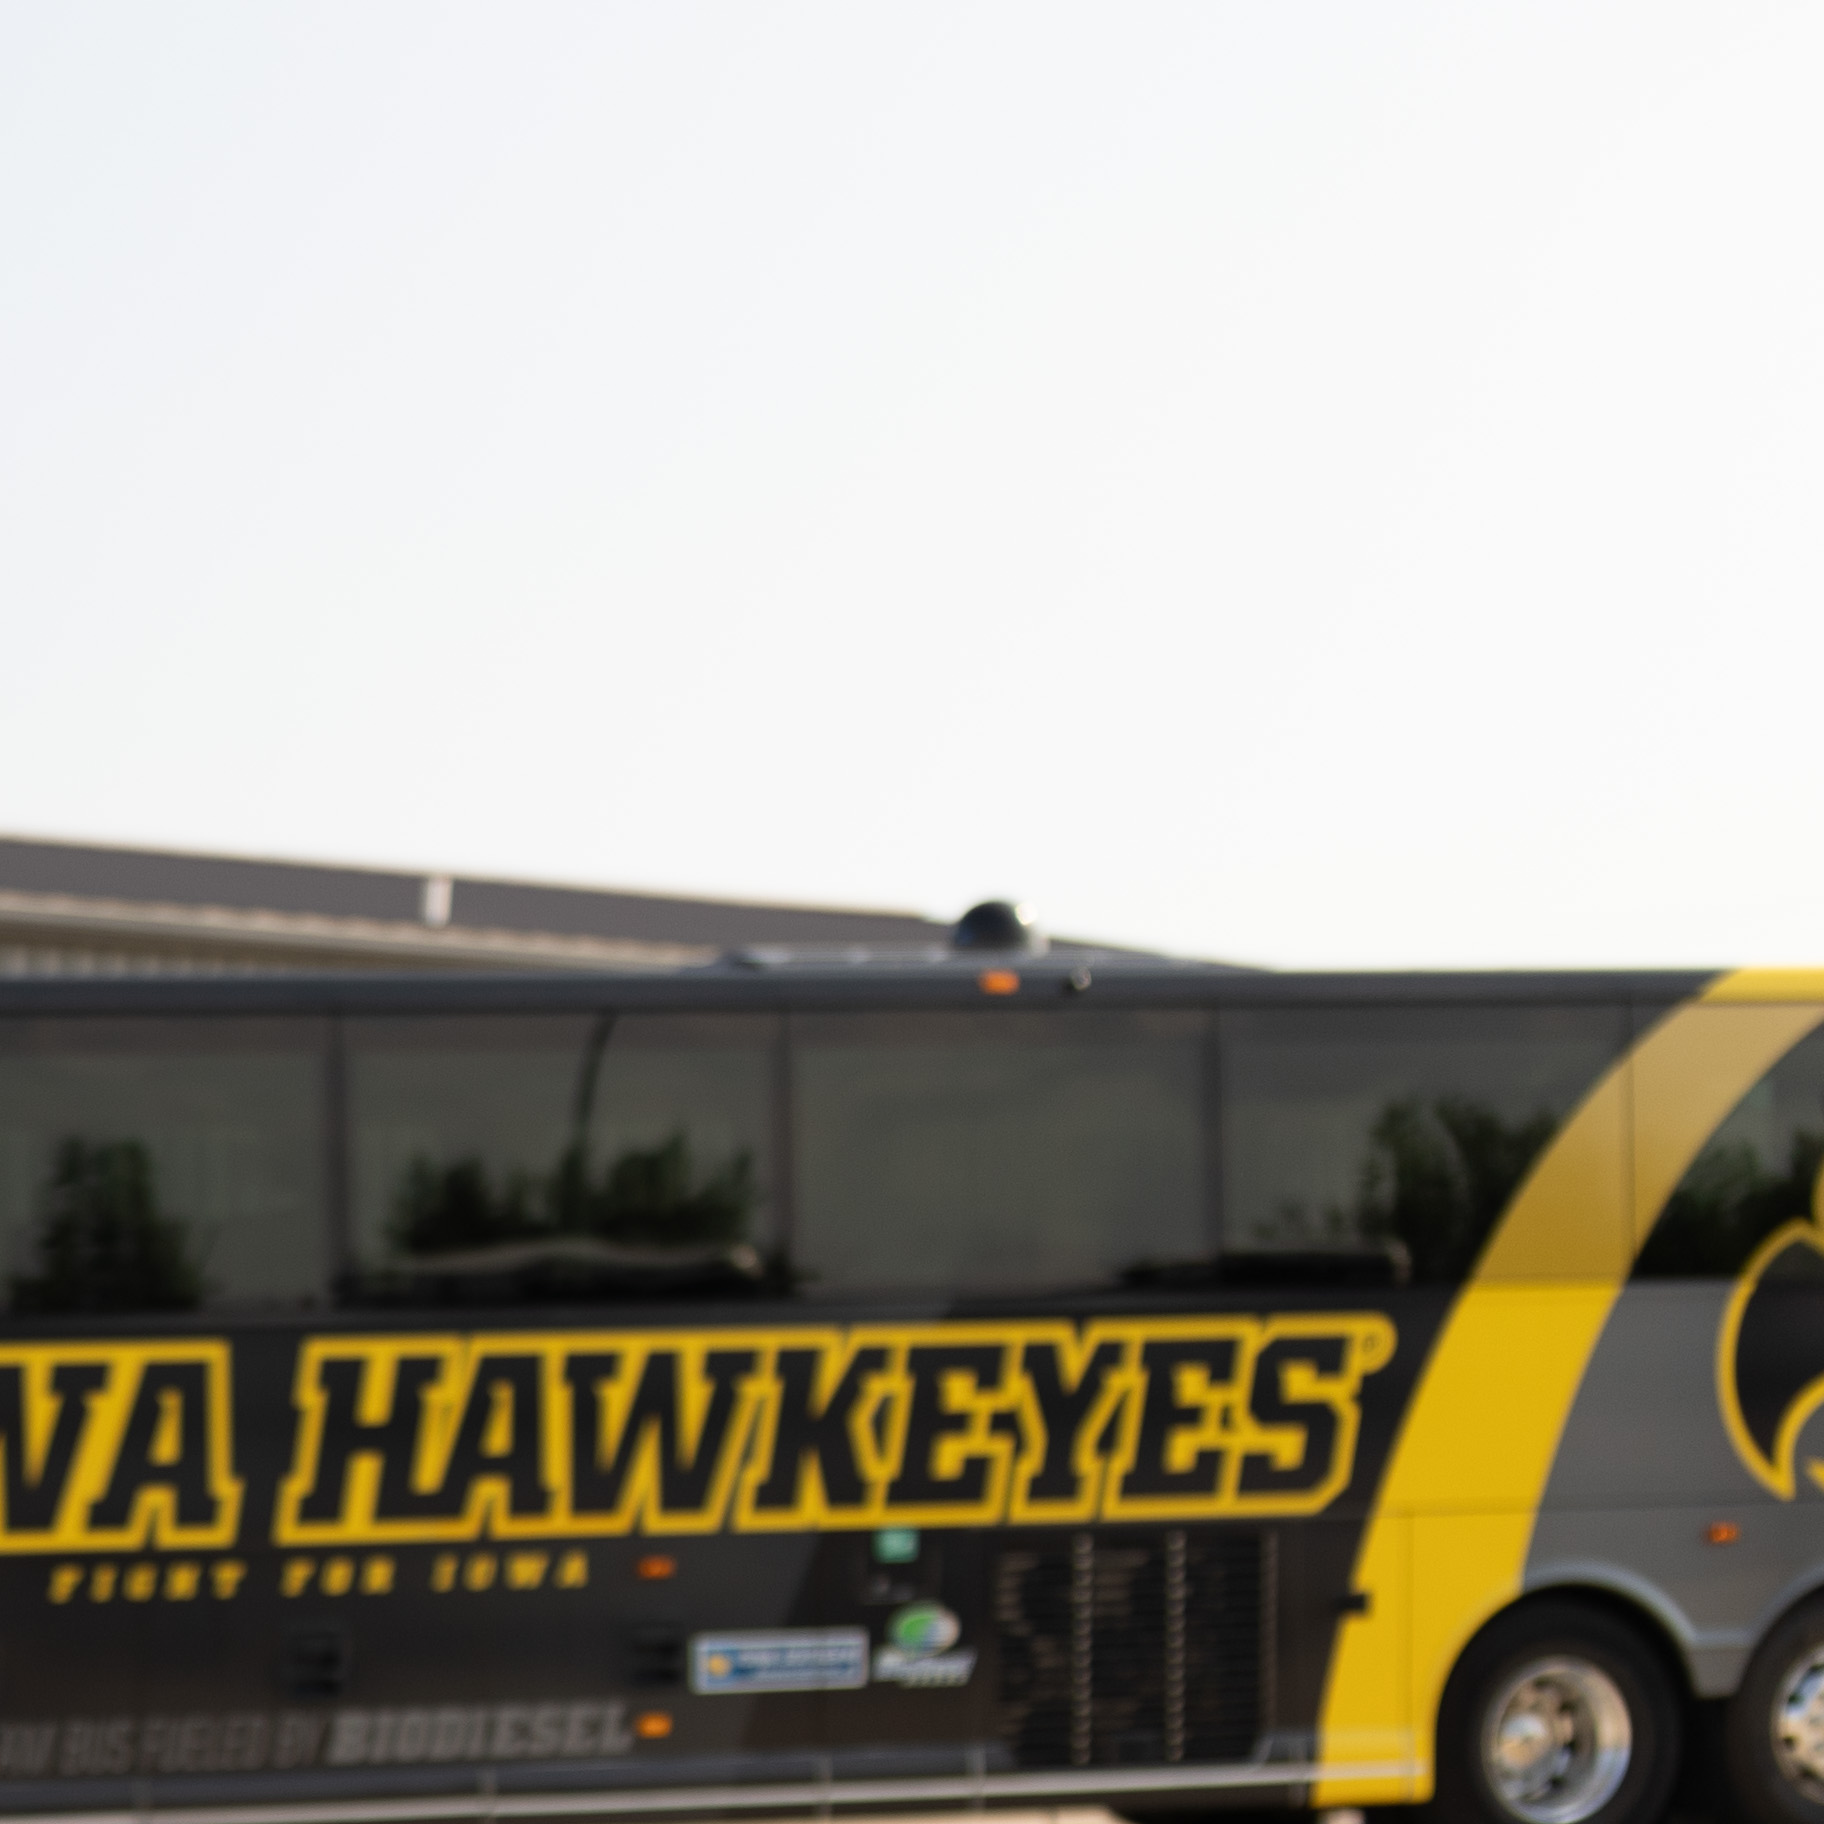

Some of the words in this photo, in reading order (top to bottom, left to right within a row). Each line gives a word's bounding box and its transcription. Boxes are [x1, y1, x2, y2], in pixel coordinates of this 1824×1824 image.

[271, 1311, 1398, 1549] HAWKEYES
[46, 1558, 248, 1603] FIGHT
[280, 1553, 397, 1598] FOR
[430, 1549, 590, 1594] IOWA
[324, 1700, 636, 1765] BIODIESEL
